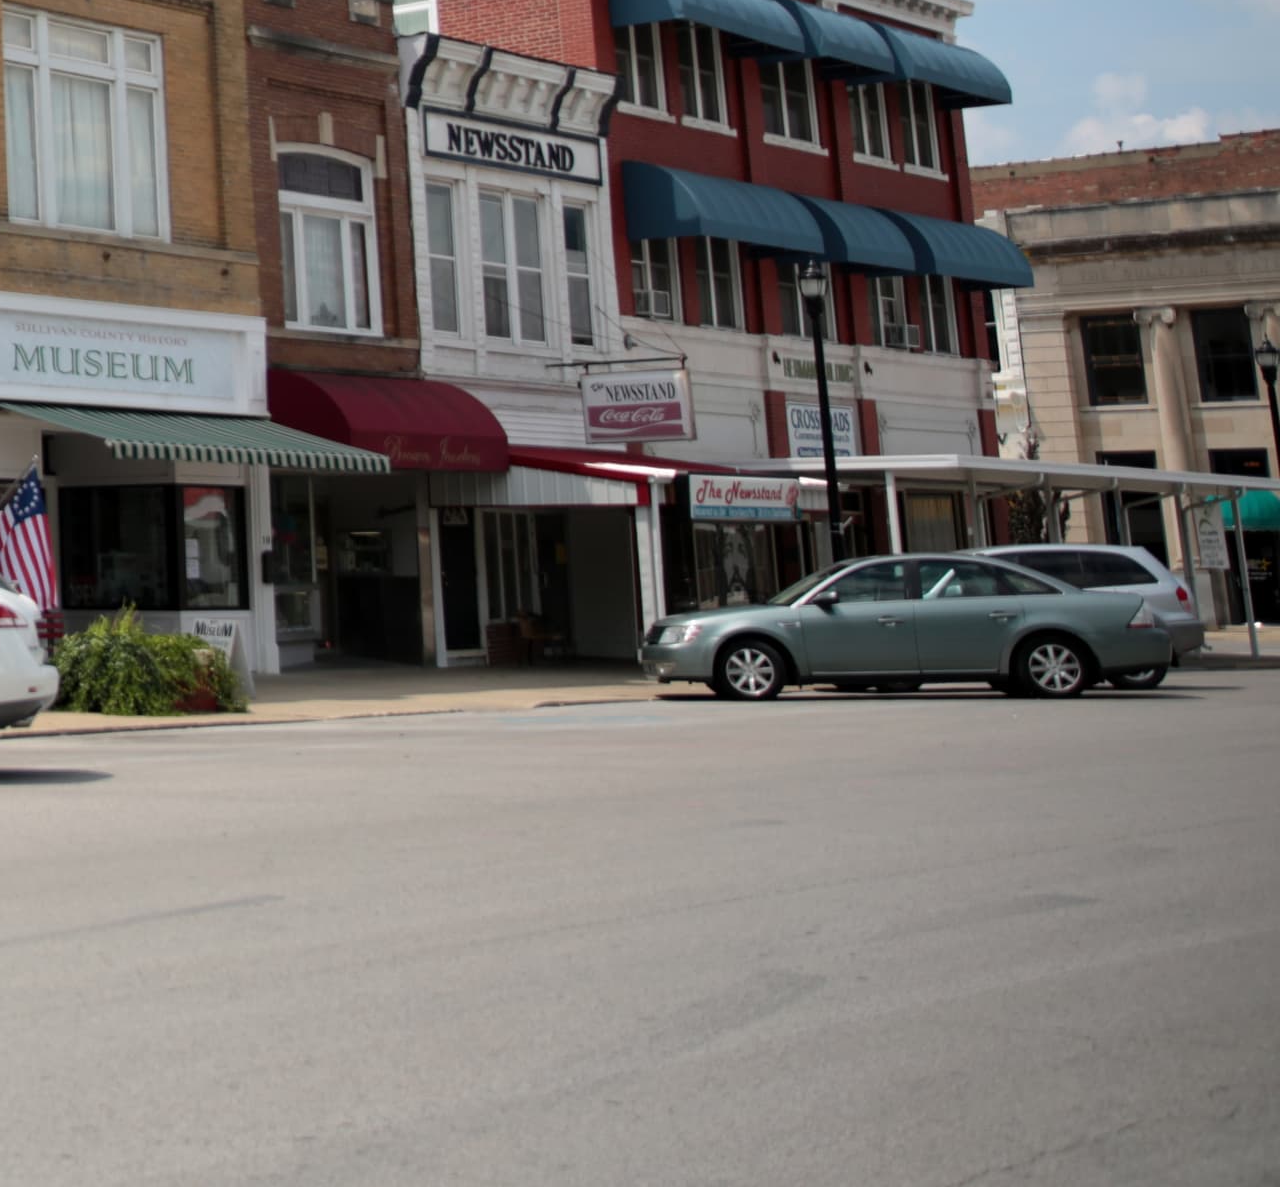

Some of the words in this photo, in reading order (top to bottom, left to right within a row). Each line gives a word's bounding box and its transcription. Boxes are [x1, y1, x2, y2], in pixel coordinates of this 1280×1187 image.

[446, 121, 575, 173] NEWSSTAND
[15, 321, 77, 337] SULLIVAN
[79, 328, 135, 342] COUNTY
[138, 333, 189, 347] HISTORY
[12, 342, 195, 385] MUSEUM
[605, 381, 677, 402] NEWSSTAND
[598, 407, 665, 423] Coca-Cola
[790, 408, 851, 432] CROSSADS
[696, 479, 722, 504] The
[725, 481, 783, 505] Newsstand
